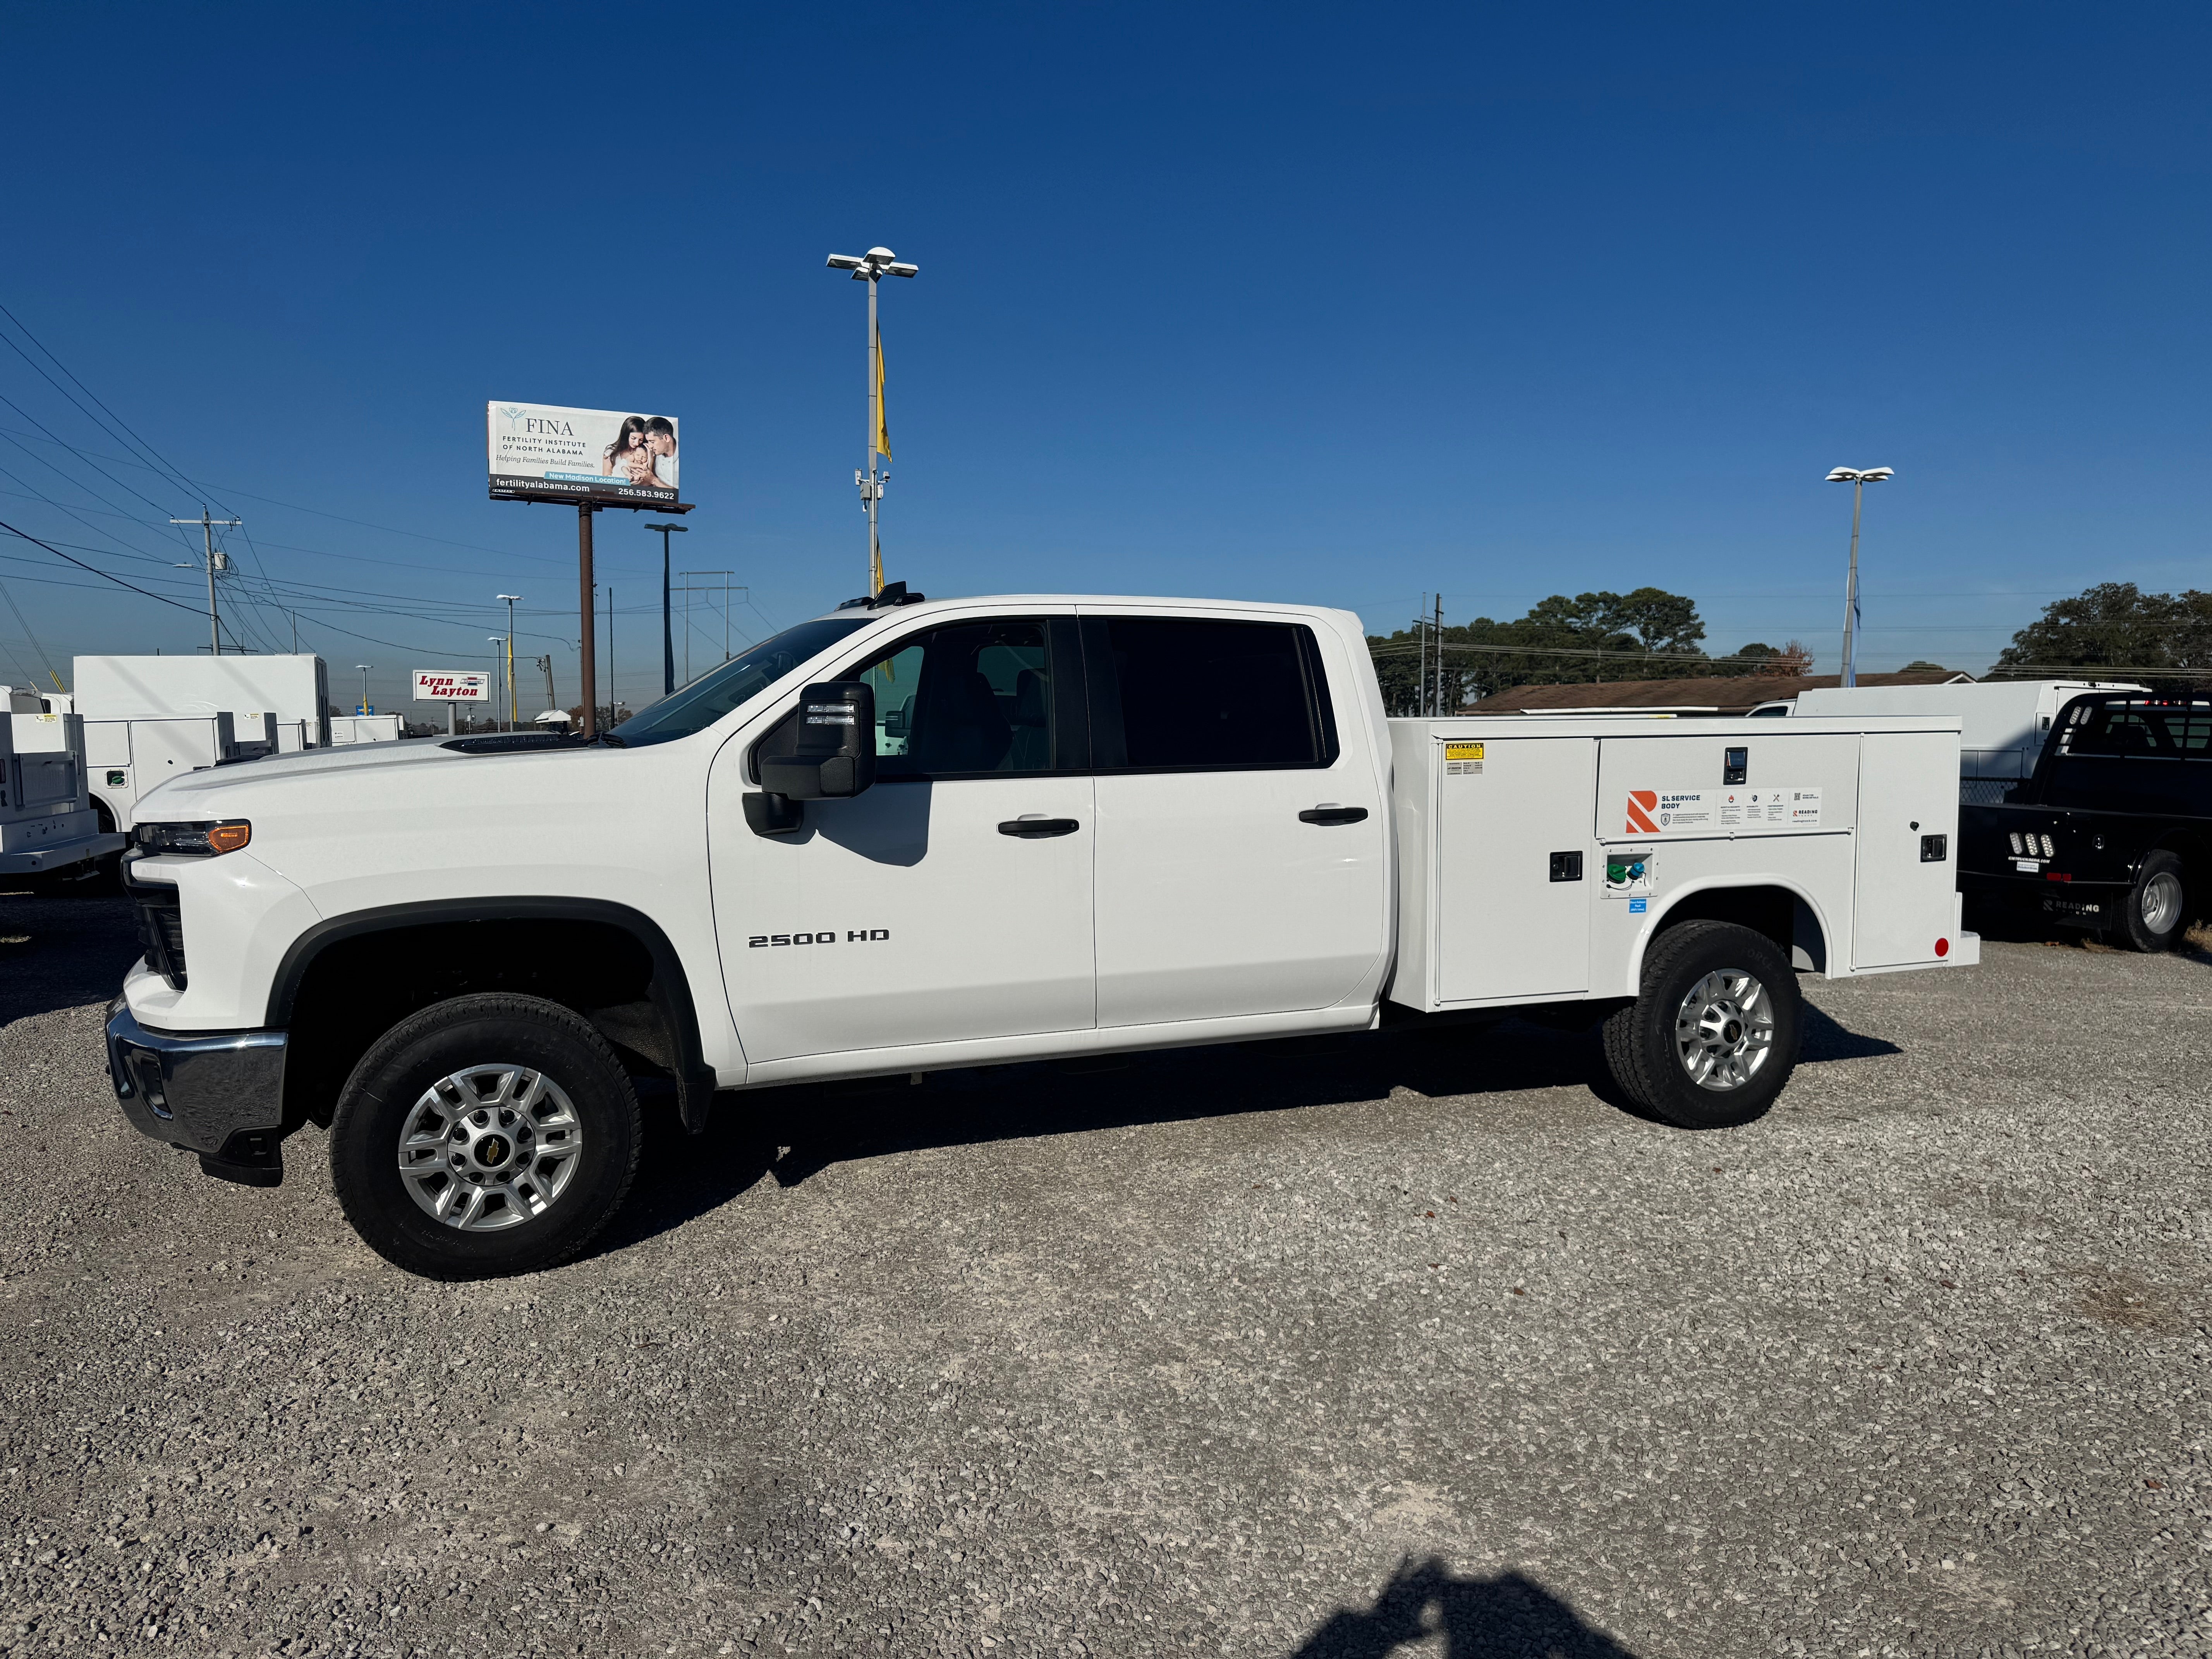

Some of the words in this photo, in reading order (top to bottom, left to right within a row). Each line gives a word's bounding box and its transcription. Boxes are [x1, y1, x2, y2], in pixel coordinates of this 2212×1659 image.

[525, 418, 574, 436] FINA
[546, 439, 586, 447] INSTITUTE
[496, 455, 521, 463] Helping
[496, 478, 590, 492] fertilityalabama.com
[595, 476, 626, 484] Location!
[618, 488, 674, 500] 256.583.9622
[419, 675, 453, 687] Lynn
[431, 686, 478, 697] Layton
[2056, 901, 2099, 912] READING
[749, 932, 836, 948] 2500
[847, 929, 890, 942] HD
